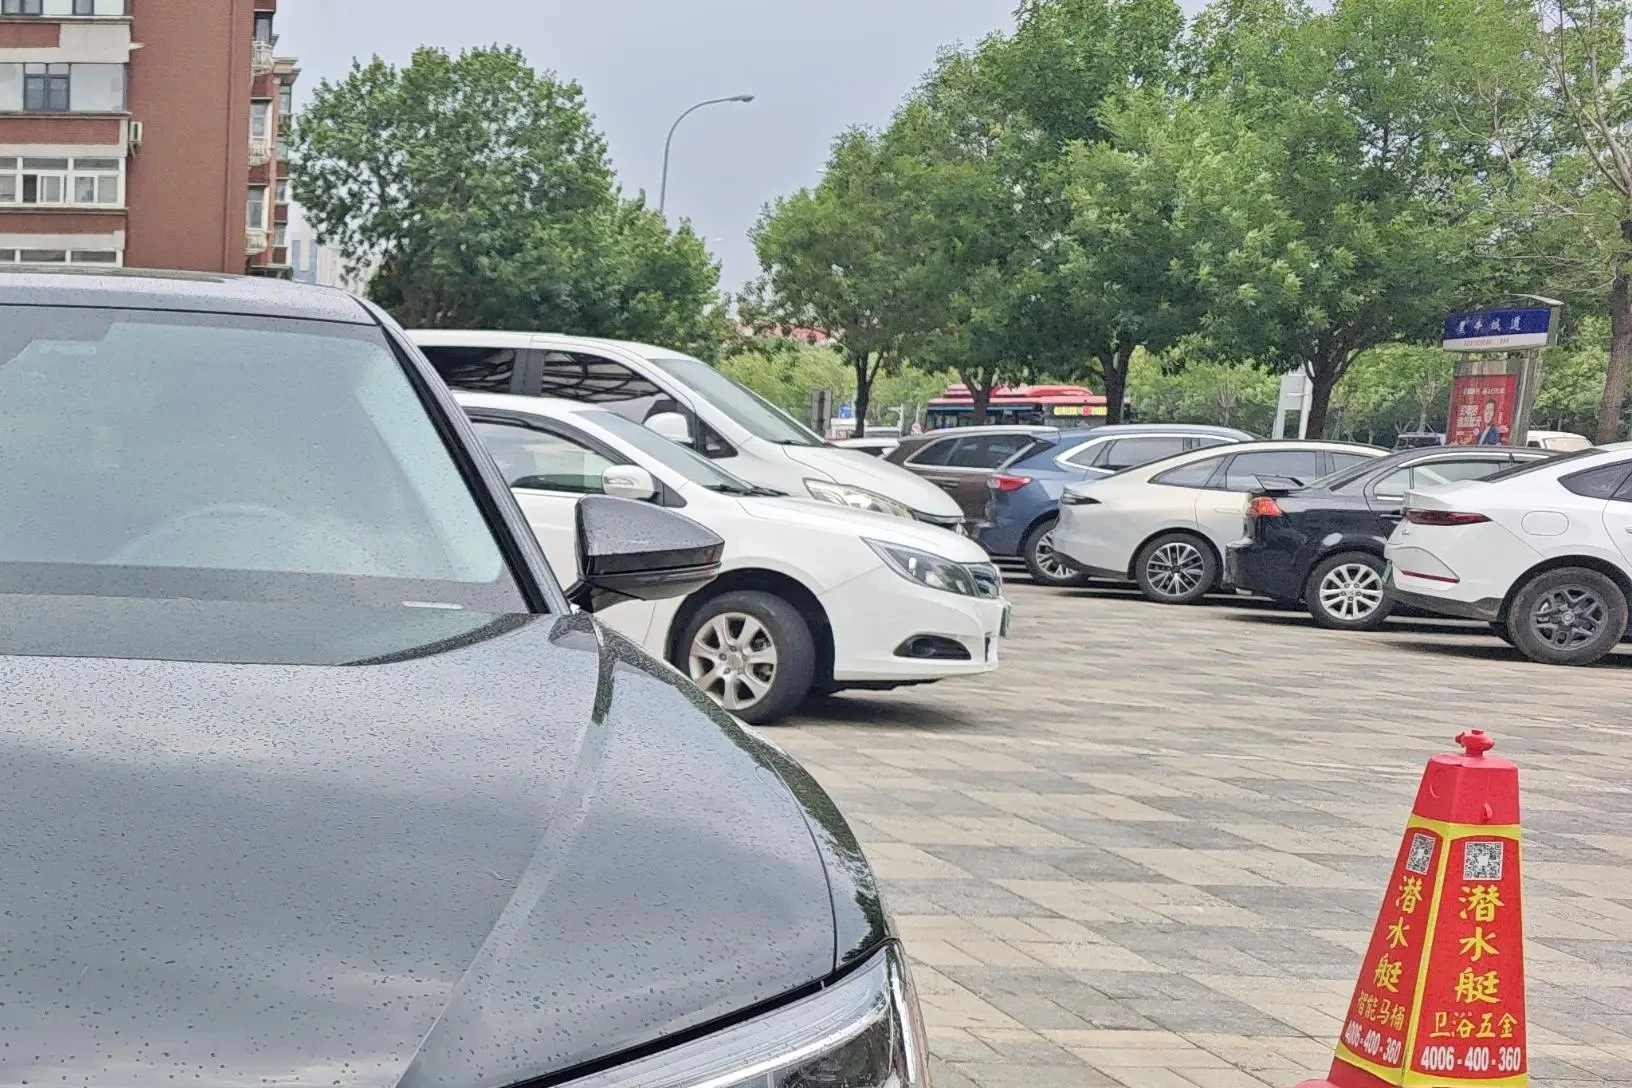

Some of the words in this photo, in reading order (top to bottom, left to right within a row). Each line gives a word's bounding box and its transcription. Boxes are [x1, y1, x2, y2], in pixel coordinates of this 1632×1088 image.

[1372, 876, 1423, 993] 潜水艇
[1454, 884, 1505, 1004] 潜水艇
[1357, 990, 1405, 1032] 智能马桶
[1428, 1012, 1518, 1039] 卫浴五金
